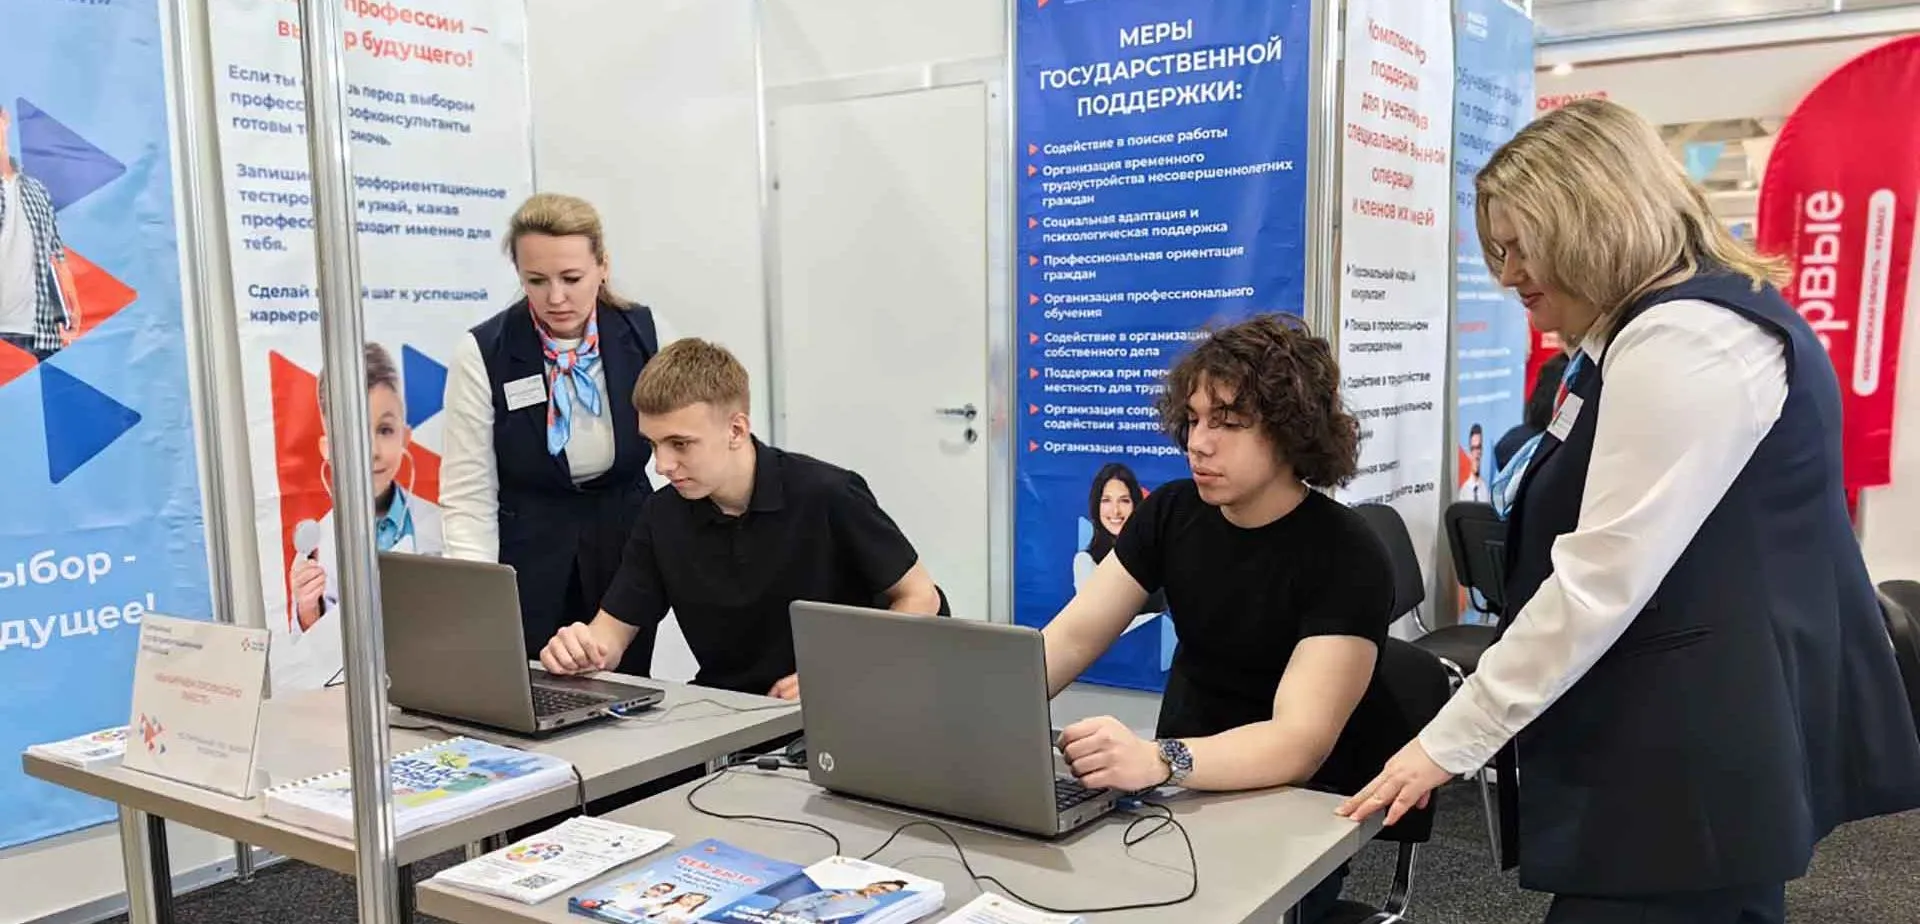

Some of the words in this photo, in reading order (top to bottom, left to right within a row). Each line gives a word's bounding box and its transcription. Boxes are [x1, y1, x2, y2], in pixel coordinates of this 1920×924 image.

[344, 0, 464, 34] профессии
[1119, 19, 1192, 47] МЕРЫ
[362, 30, 473, 67] будущего!
[1040, 35, 1282, 90] ГОСУДАРСТВЕННОЙ
[228, 64, 270, 83] Если
[274, 74, 296, 87] ты
[362, 85, 405, 104] перед
[410, 93, 475, 113] выбором
[1077, 80, 1242, 117] ПОДДЕРЖКИ:
[230, 91, 305, 111] професс
[232, 117, 292, 134] готовы
[350, 130, 391, 146] омочь.
[1043, 140, 1114, 155] Содействие
[1117, 138, 1124, 147] в
[1127, 133, 1174, 146] поиске
[1177, 128, 1228, 144] работы
[1042, 161, 1121, 178] Организация
[1124, 153, 1205, 170] временного
[235, 163, 310, 181] Запиши
[355, 176, 507, 199] рофориентационное
[1042, 174, 1145, 193] трудоустройства
[1148, 161, 1293, 182] несовершеннолетних
[239, 190, 313, 207] тестиро
[368, 201, 412, 214] узнай,
[416, 204, 459, 215] какая
[1042, 195, 1095, 208] граждан
[241, 213, 314, 230] професс
[356, 222, 401, 235] дходит
[406, 225, 464, 238] именно
[467, 228, 491, 239] для
[1043, 215, 1116, 229] Социальная
[1118, 210, 1186, 223] адаптация
[1190, 209, 1199, 218] и
[1043, 228, 1148, 243] психологическая
[1152, 223, 1228, 237] поддержка
[243, 237, 288, 251] тебя.
[1043, 252, 1163, 267] Профессиональная
[1166, 246, 1244, 261] ориентация
[1043, 270, 1096, 282] граждан
[1796, 190, 1848, 349] рвые
[248, 284, 309, 299] Сделай
[371, 289, 394, 299] шаг
[400, 290, 408, 299] к
[414, 288, 488, 302] успешной
[1044, 292, 1124, 306] Организация
[1127, 286, 1254, 303] профессионального
[1044, 307, 1102, 320] обучения
[1044, 331, 1116, 343] Содействие
[1120, 333, 1126, 341] в
[1044, 347, 1127, 358] собственного
[1129, 347, 1160, 357] дела
[1044, 367, 1113, 379] Поддержка
[1117, 369, 1140, 379] при
[1044, 384, 1106, 393] местность
[1108, 384, 1132, 394] для
[1044, 404, 1123, 416] Организация
[1044, 418, 1114, 430] содействии
[1044, 441, 1125, 454] Организация
[1126, 444, 1180, 456] ярмарок
[0, 549, 112, 589] ыбор
[0, 592, 155, 651] дущее!
